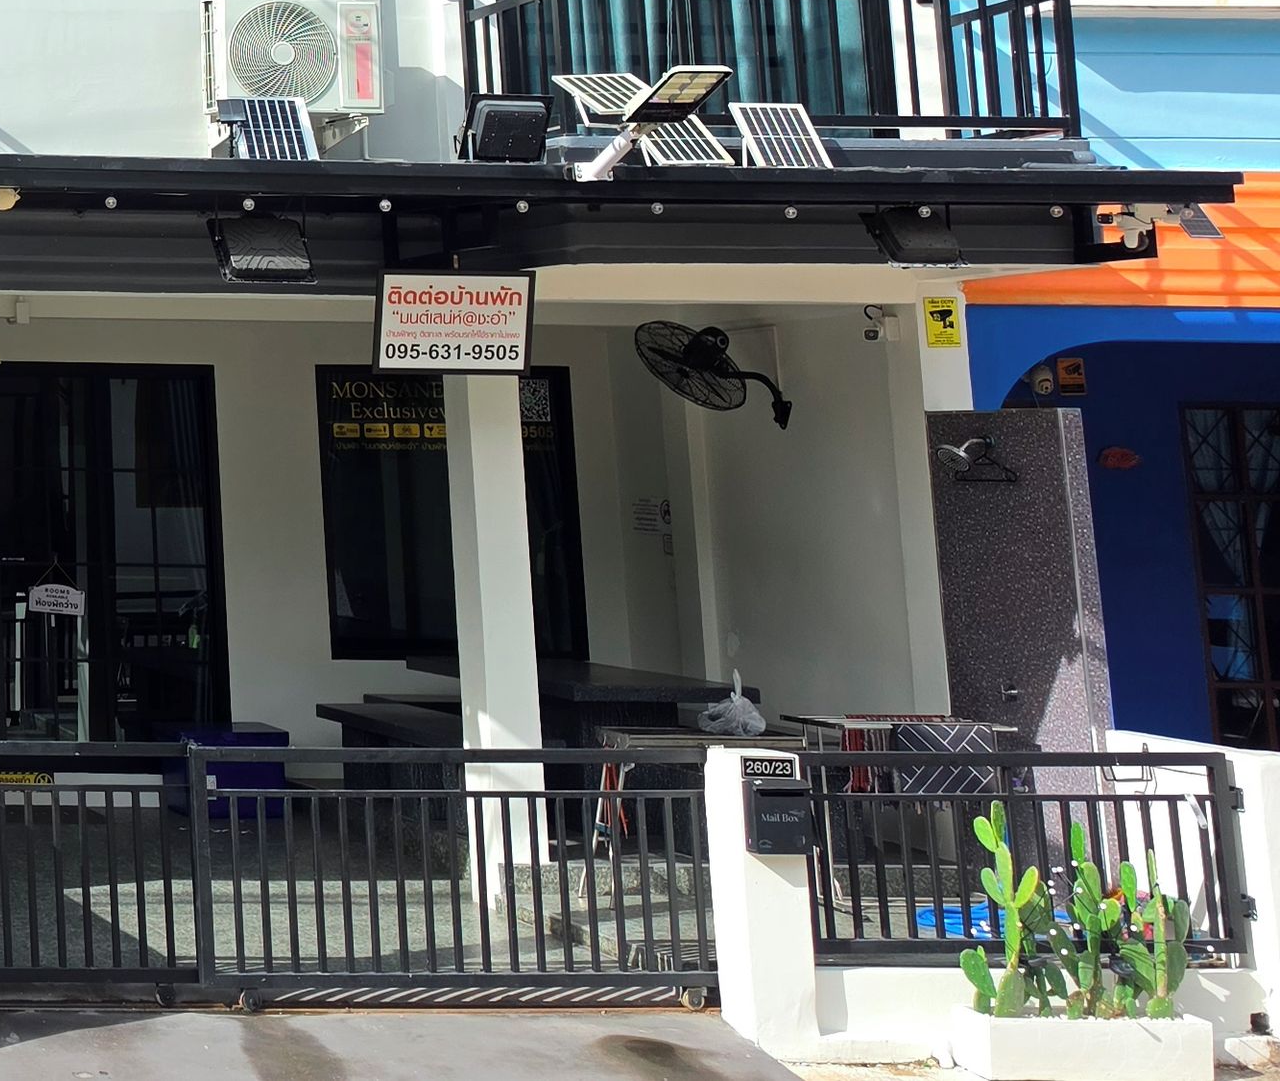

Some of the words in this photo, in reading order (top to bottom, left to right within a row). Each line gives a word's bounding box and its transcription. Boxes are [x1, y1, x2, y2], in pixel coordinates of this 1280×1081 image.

[387, 285, 523, 306] ติดต่อบ้านพัก
[385, 343, 520, 361] 095-631-9505
[35, 597, 79, 609] ห้องพักว่าง
[746, 761, 791, 774] 260/23
[761, 813, 781, 822] Mail
[782, 813, 799, 822] Box
